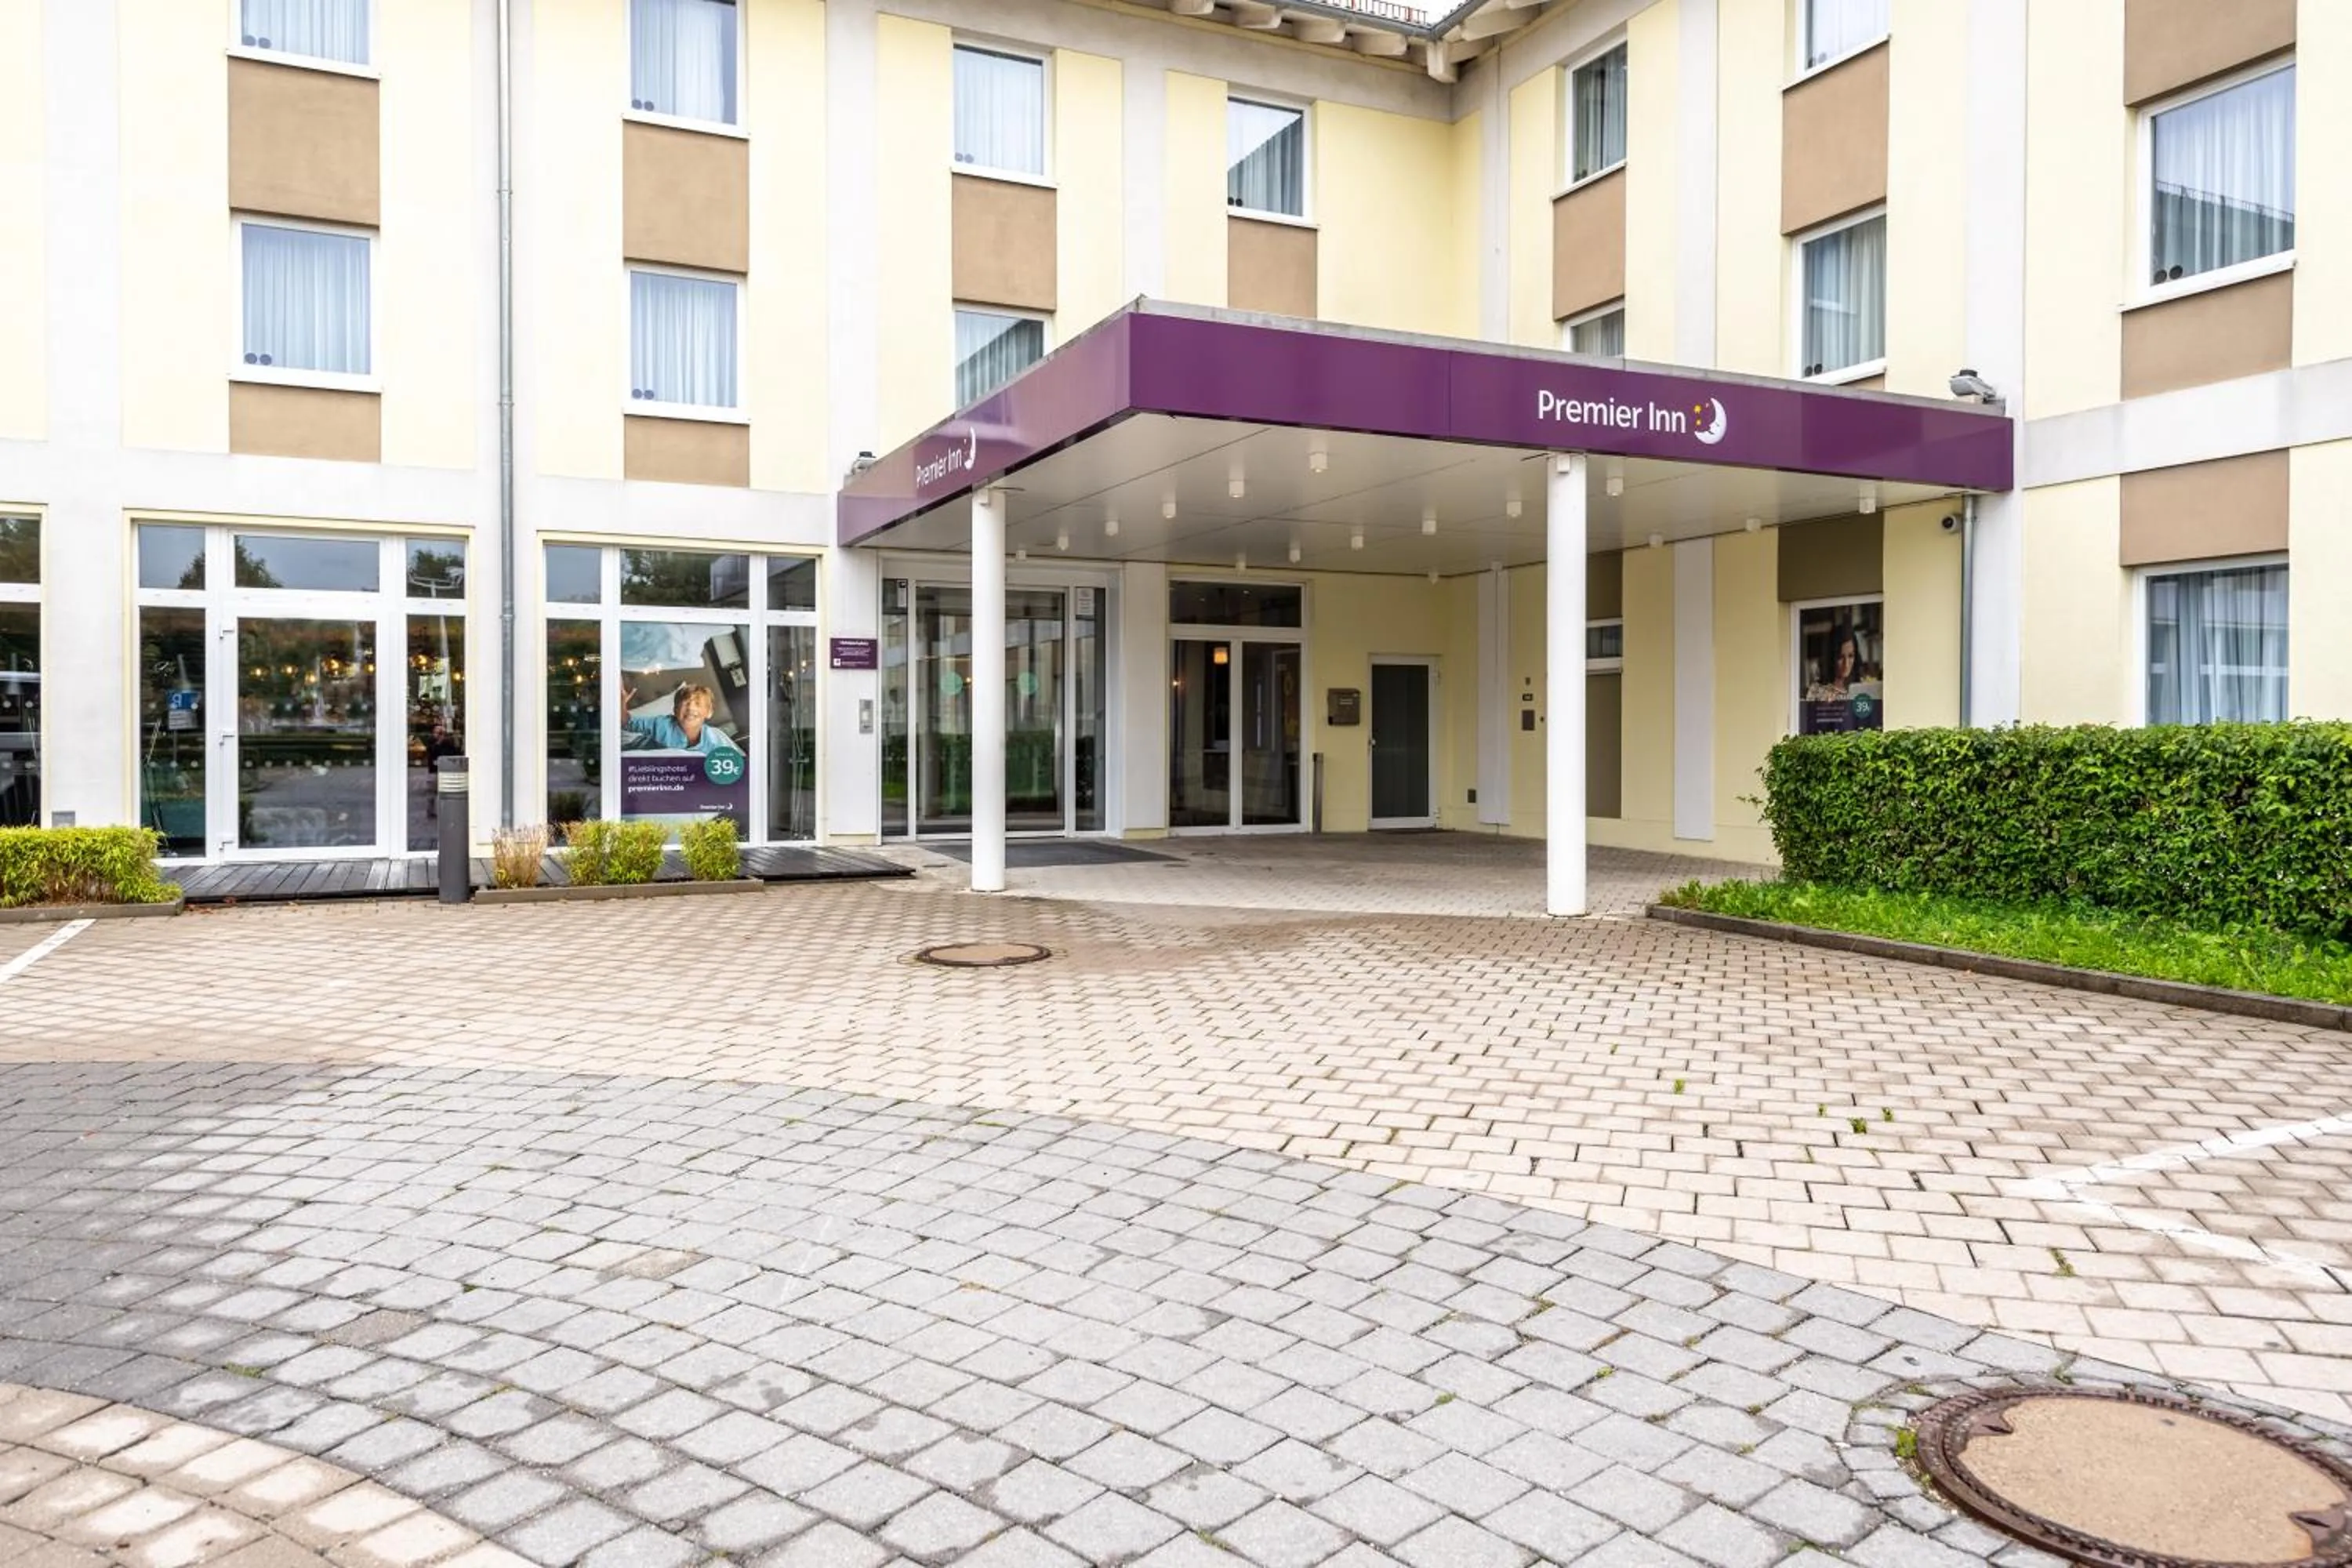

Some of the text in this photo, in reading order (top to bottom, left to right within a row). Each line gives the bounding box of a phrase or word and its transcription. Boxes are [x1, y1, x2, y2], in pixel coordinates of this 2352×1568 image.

[1538, 390, 1686, 434] Premier Inn
[948, 448, 962, 473] Inn
[711, 759, 740, 775] 39€
